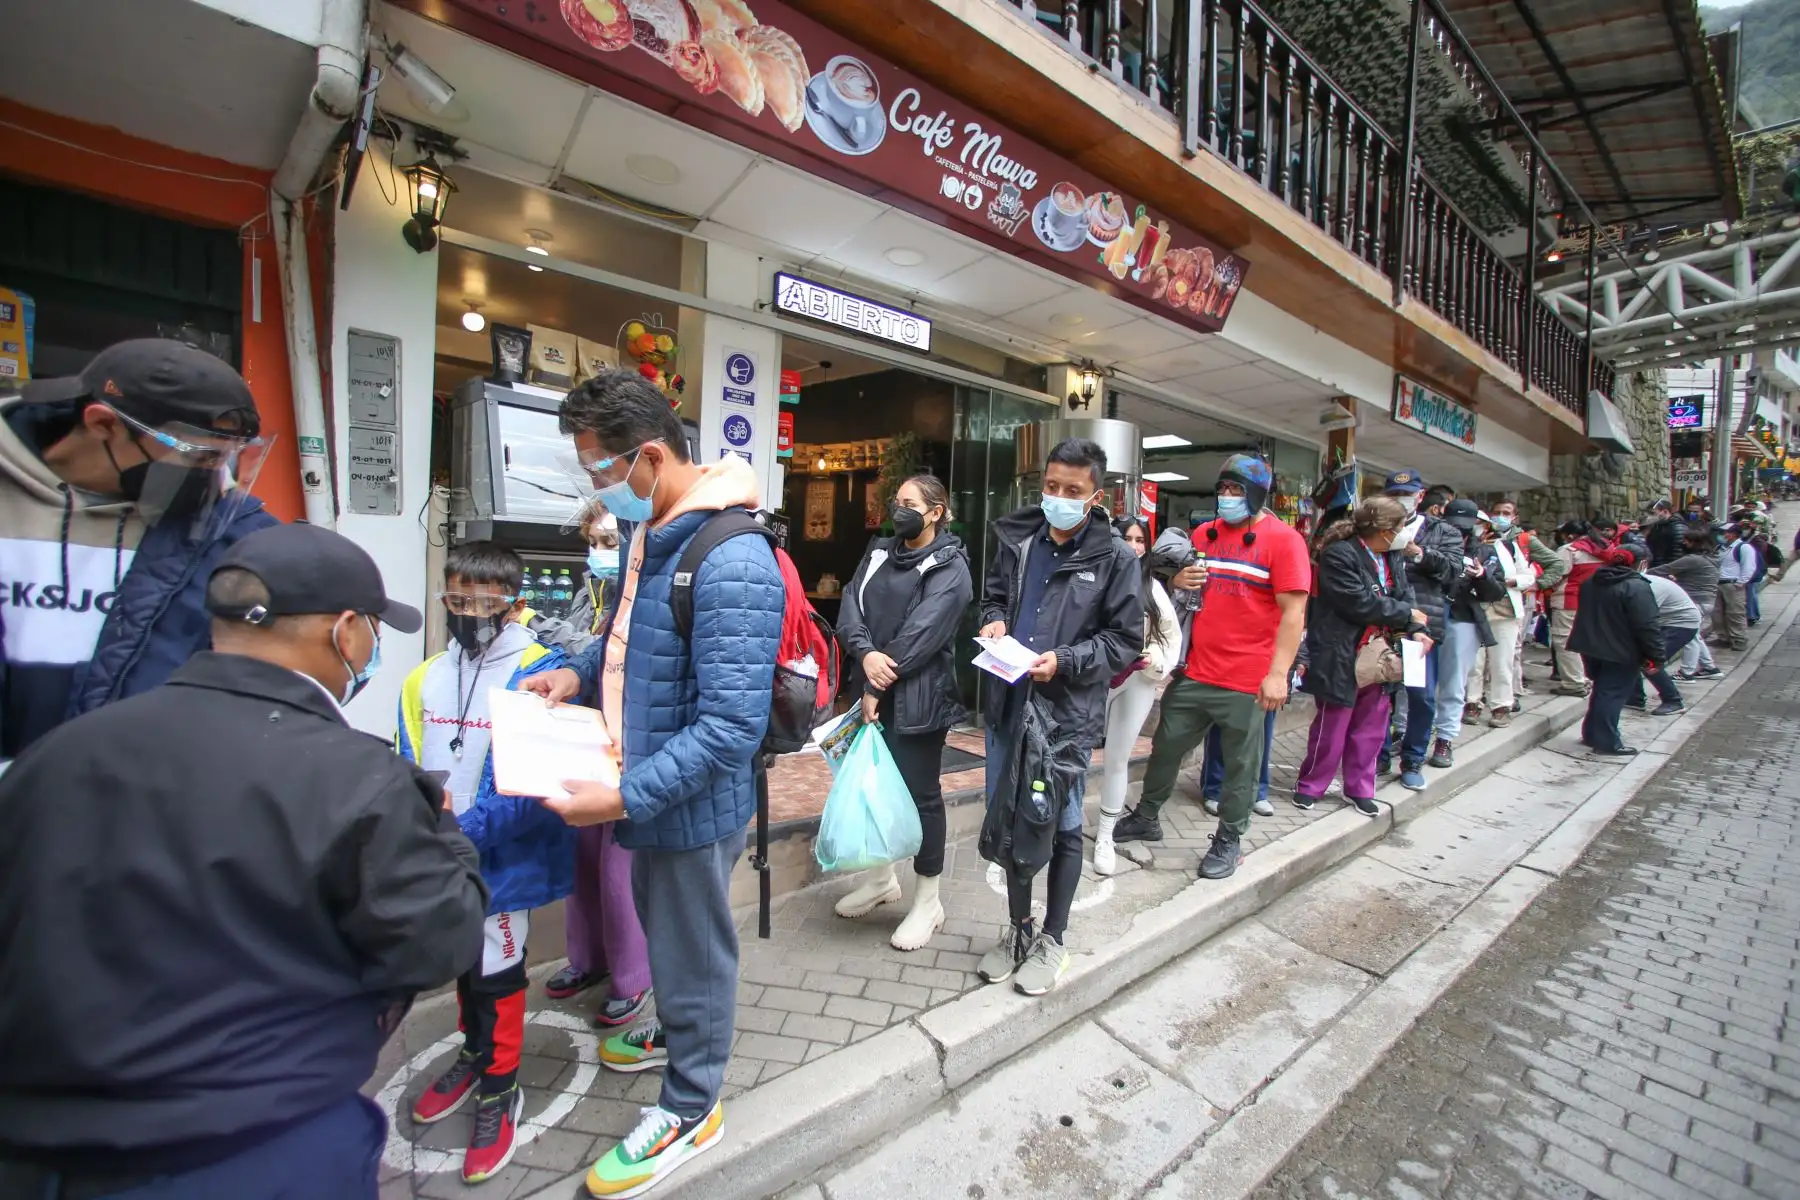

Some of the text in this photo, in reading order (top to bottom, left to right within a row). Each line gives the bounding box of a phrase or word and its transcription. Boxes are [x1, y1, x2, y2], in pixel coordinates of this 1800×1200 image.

[889, 88, 1038, 191] Café Mawa
[935, 155, 963, 174] CAFETERÍA
[968, 171, 997, 190] PASTELERÍA
[784, 282, 920, 344] ABIERTO
